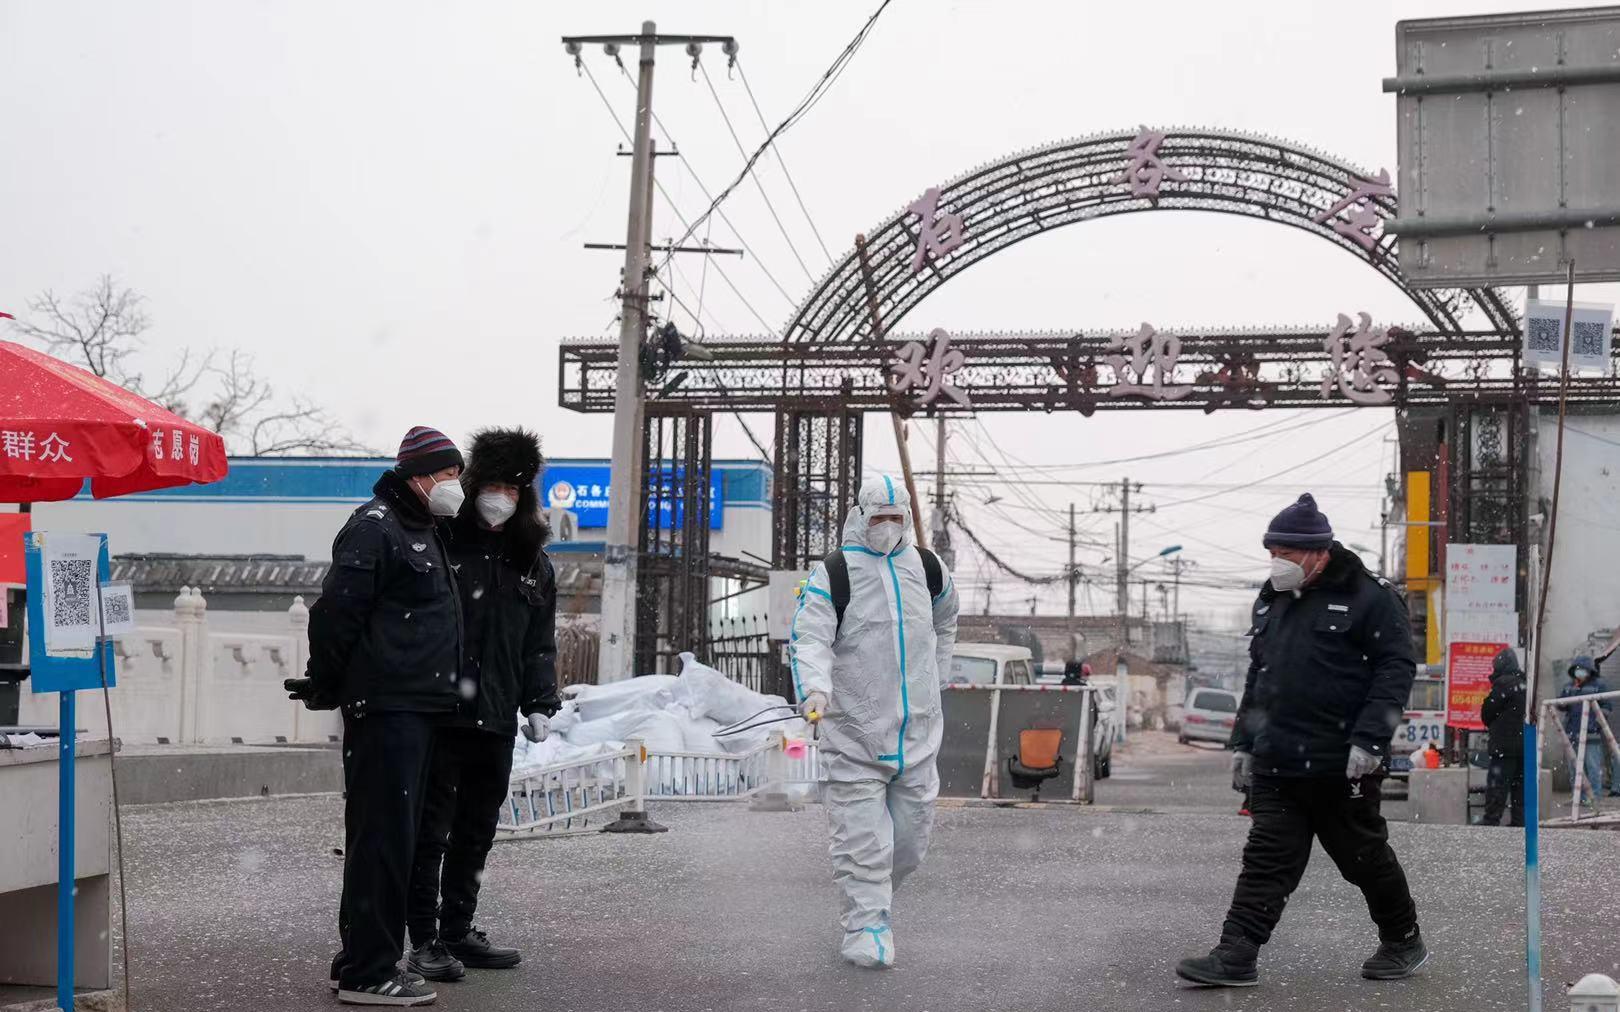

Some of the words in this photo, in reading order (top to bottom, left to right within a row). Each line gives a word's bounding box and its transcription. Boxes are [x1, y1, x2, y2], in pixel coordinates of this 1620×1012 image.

[907, 125, 1392, 272] 石各庄
[889, 311, 1400, 410] 欢迎您
[1, 430, 73, 463] 群众
